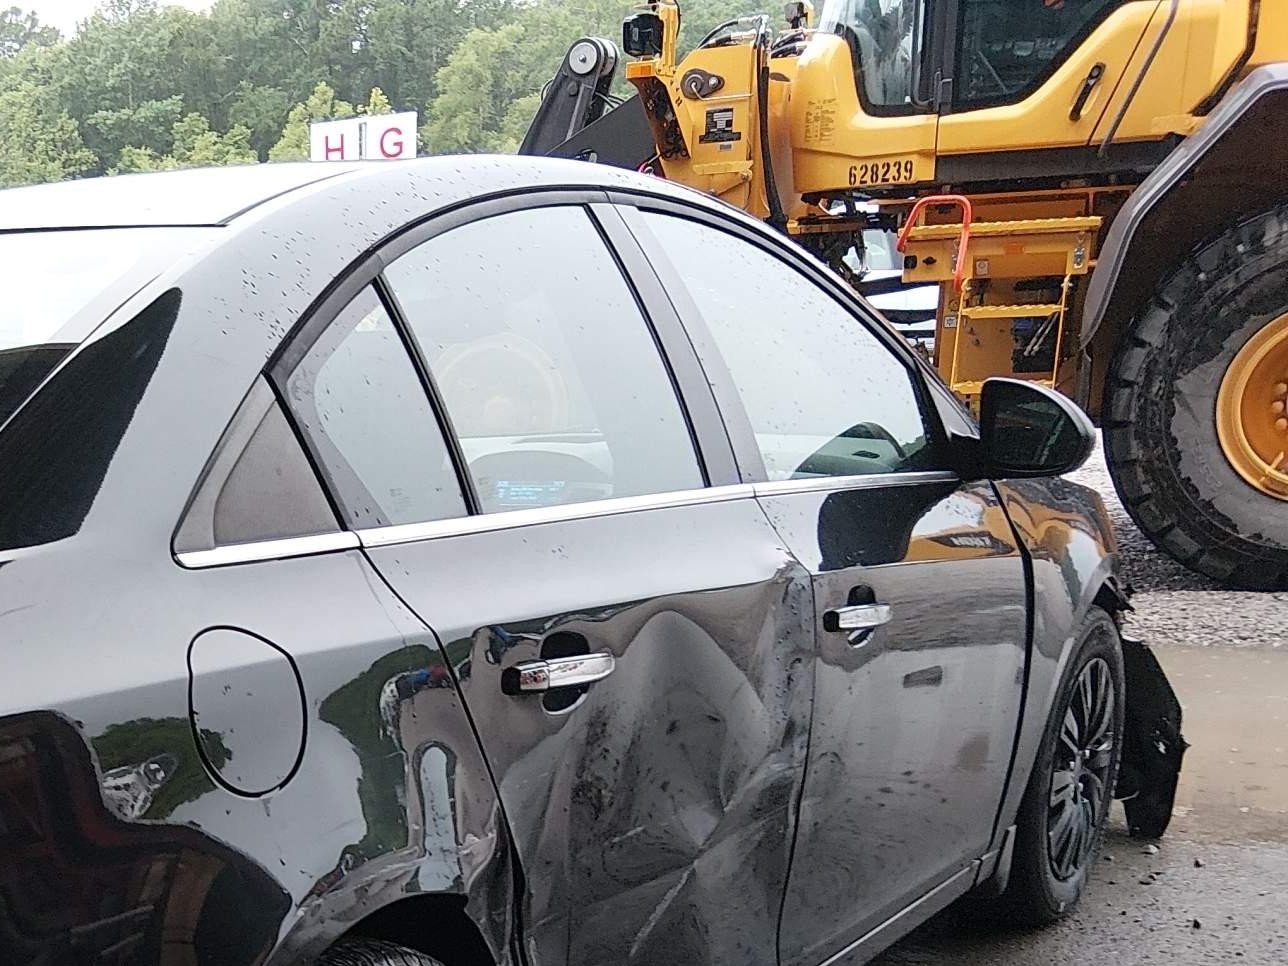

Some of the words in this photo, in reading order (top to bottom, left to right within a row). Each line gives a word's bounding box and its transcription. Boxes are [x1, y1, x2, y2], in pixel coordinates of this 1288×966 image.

[325, 133, 344, 160] H
[380, 127, 403, 158] G
[848, 160, 914, 186] 628239
